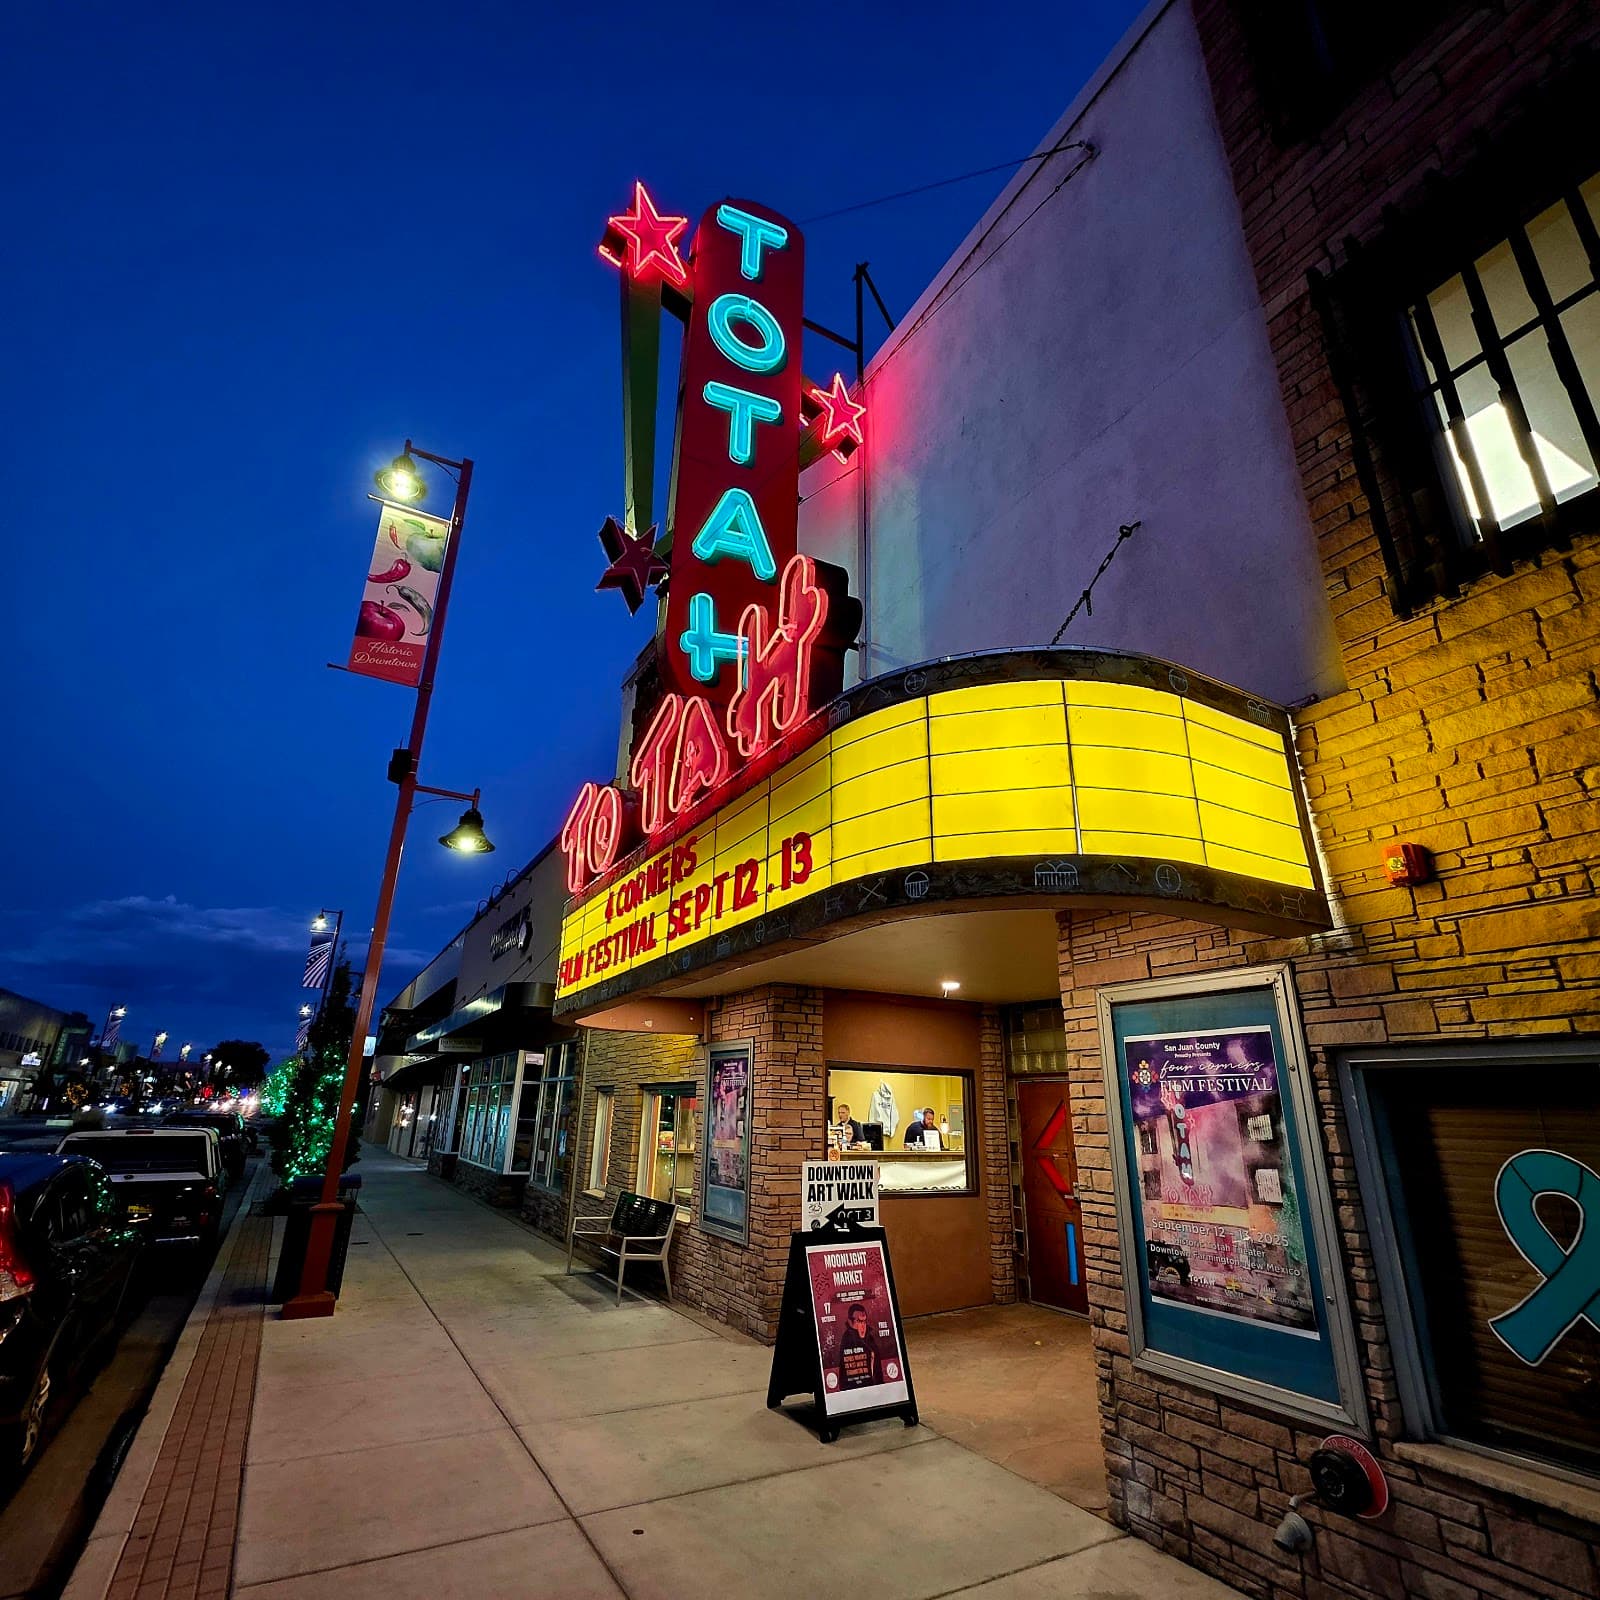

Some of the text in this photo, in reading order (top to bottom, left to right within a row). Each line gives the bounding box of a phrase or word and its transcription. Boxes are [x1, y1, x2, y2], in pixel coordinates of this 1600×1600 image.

[368, 641, 413, 657] Historic
[354, 653, 420, 669] Downtown
[616, 836, 698, 917] CORNERS
[559, 949, 583, 988] FILM
[585, 912, 657, 978] FESTIVAL
[668, 871, 729, 941] SEPT
[1164, 1044, 1176, 1052] San
[1195, 1041, 1220, 1050] County
[1160, 1059, 1265, 1079] four corners
[1160, 1078, 1273, 1092] FILM FESTIVAL
[807, 1165, 874, 1181] DOWNTOWN
[807, 1183, 834, 1202] ART
[837, 1182, 874, 1201] WALK
[864, 1209, 872, 1220] 3
[1151, 1218, 1210, 1236] September
[1214, 1227, 1226, 1238] 12
[1257, 1232, 1289, 1247] 2025
[823, 1251, 867, 1269] MOONLIGHT
[1150, 1244, 1191, 1258] Downtown
[1244, 1258, 1264, 1271] New
[1267, 1263, 1301, 1277] Mexico
[832, 1269, 863, 1287] MARKET
